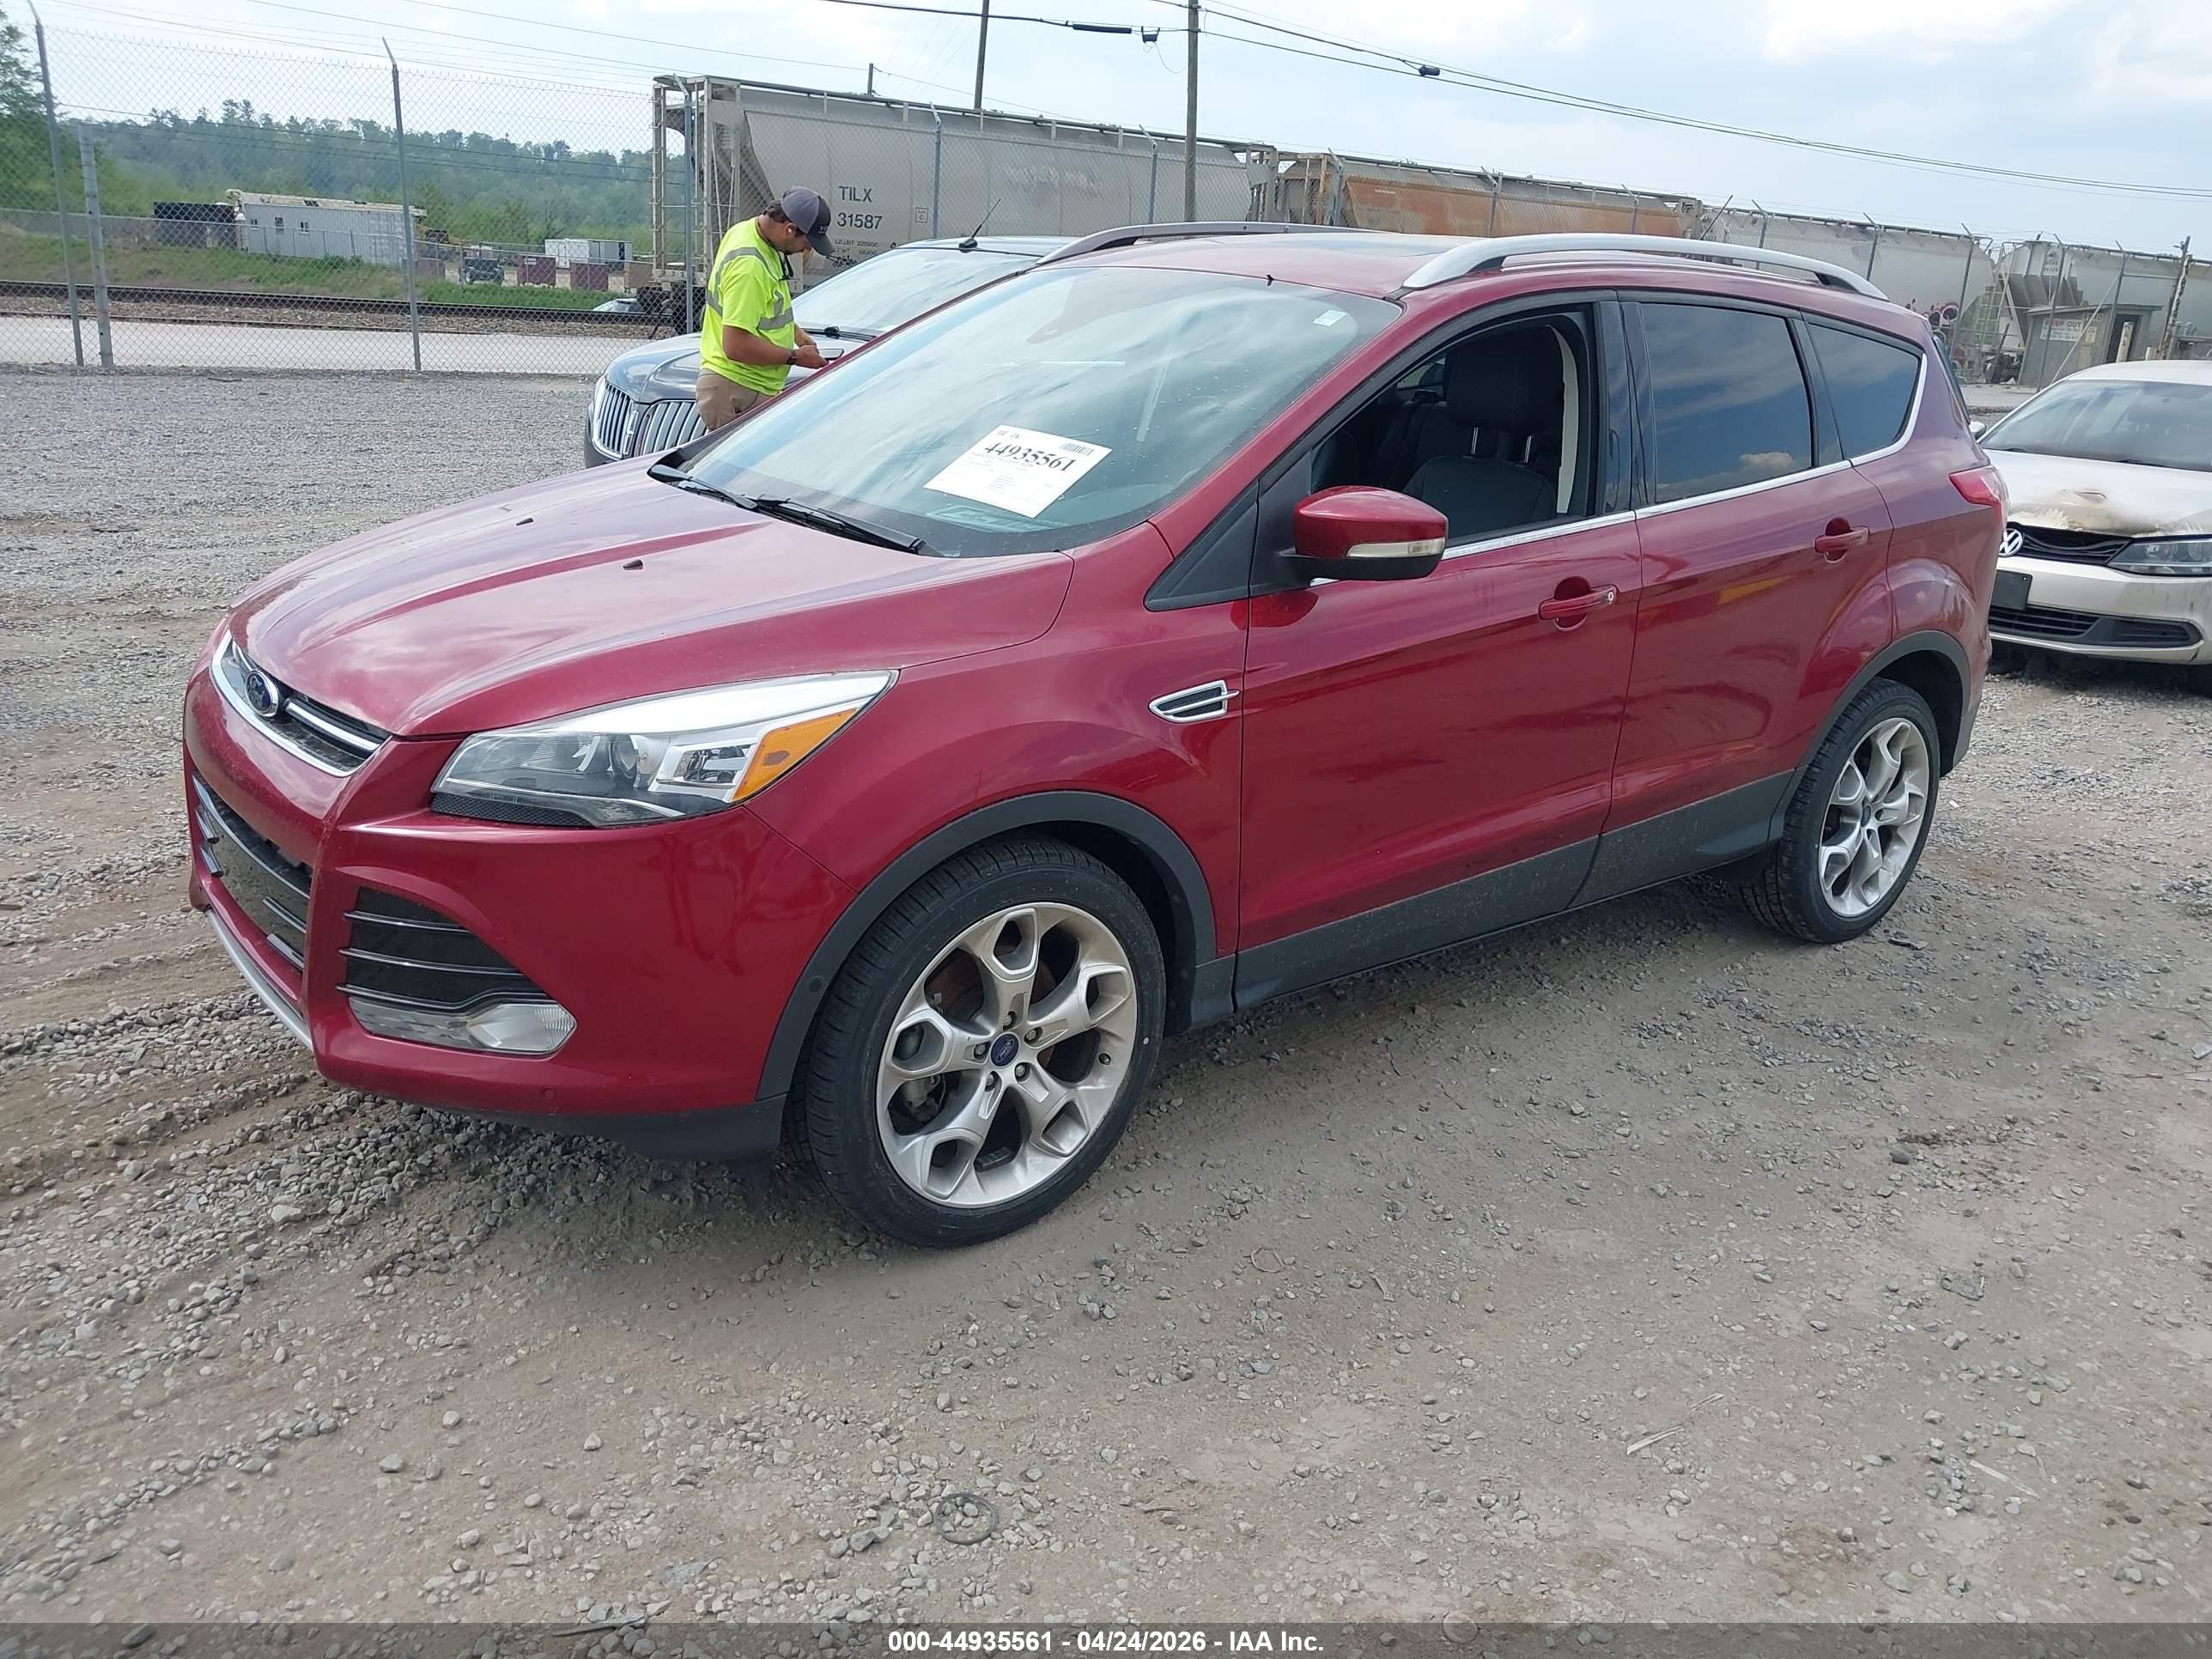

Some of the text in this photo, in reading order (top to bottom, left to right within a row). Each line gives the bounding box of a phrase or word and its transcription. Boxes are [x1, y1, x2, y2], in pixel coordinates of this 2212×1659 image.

[838, 185, 872, 203] TILX
[836, 212, 884, 230] 31587
[984, 442, 1077, 472] 44935561
